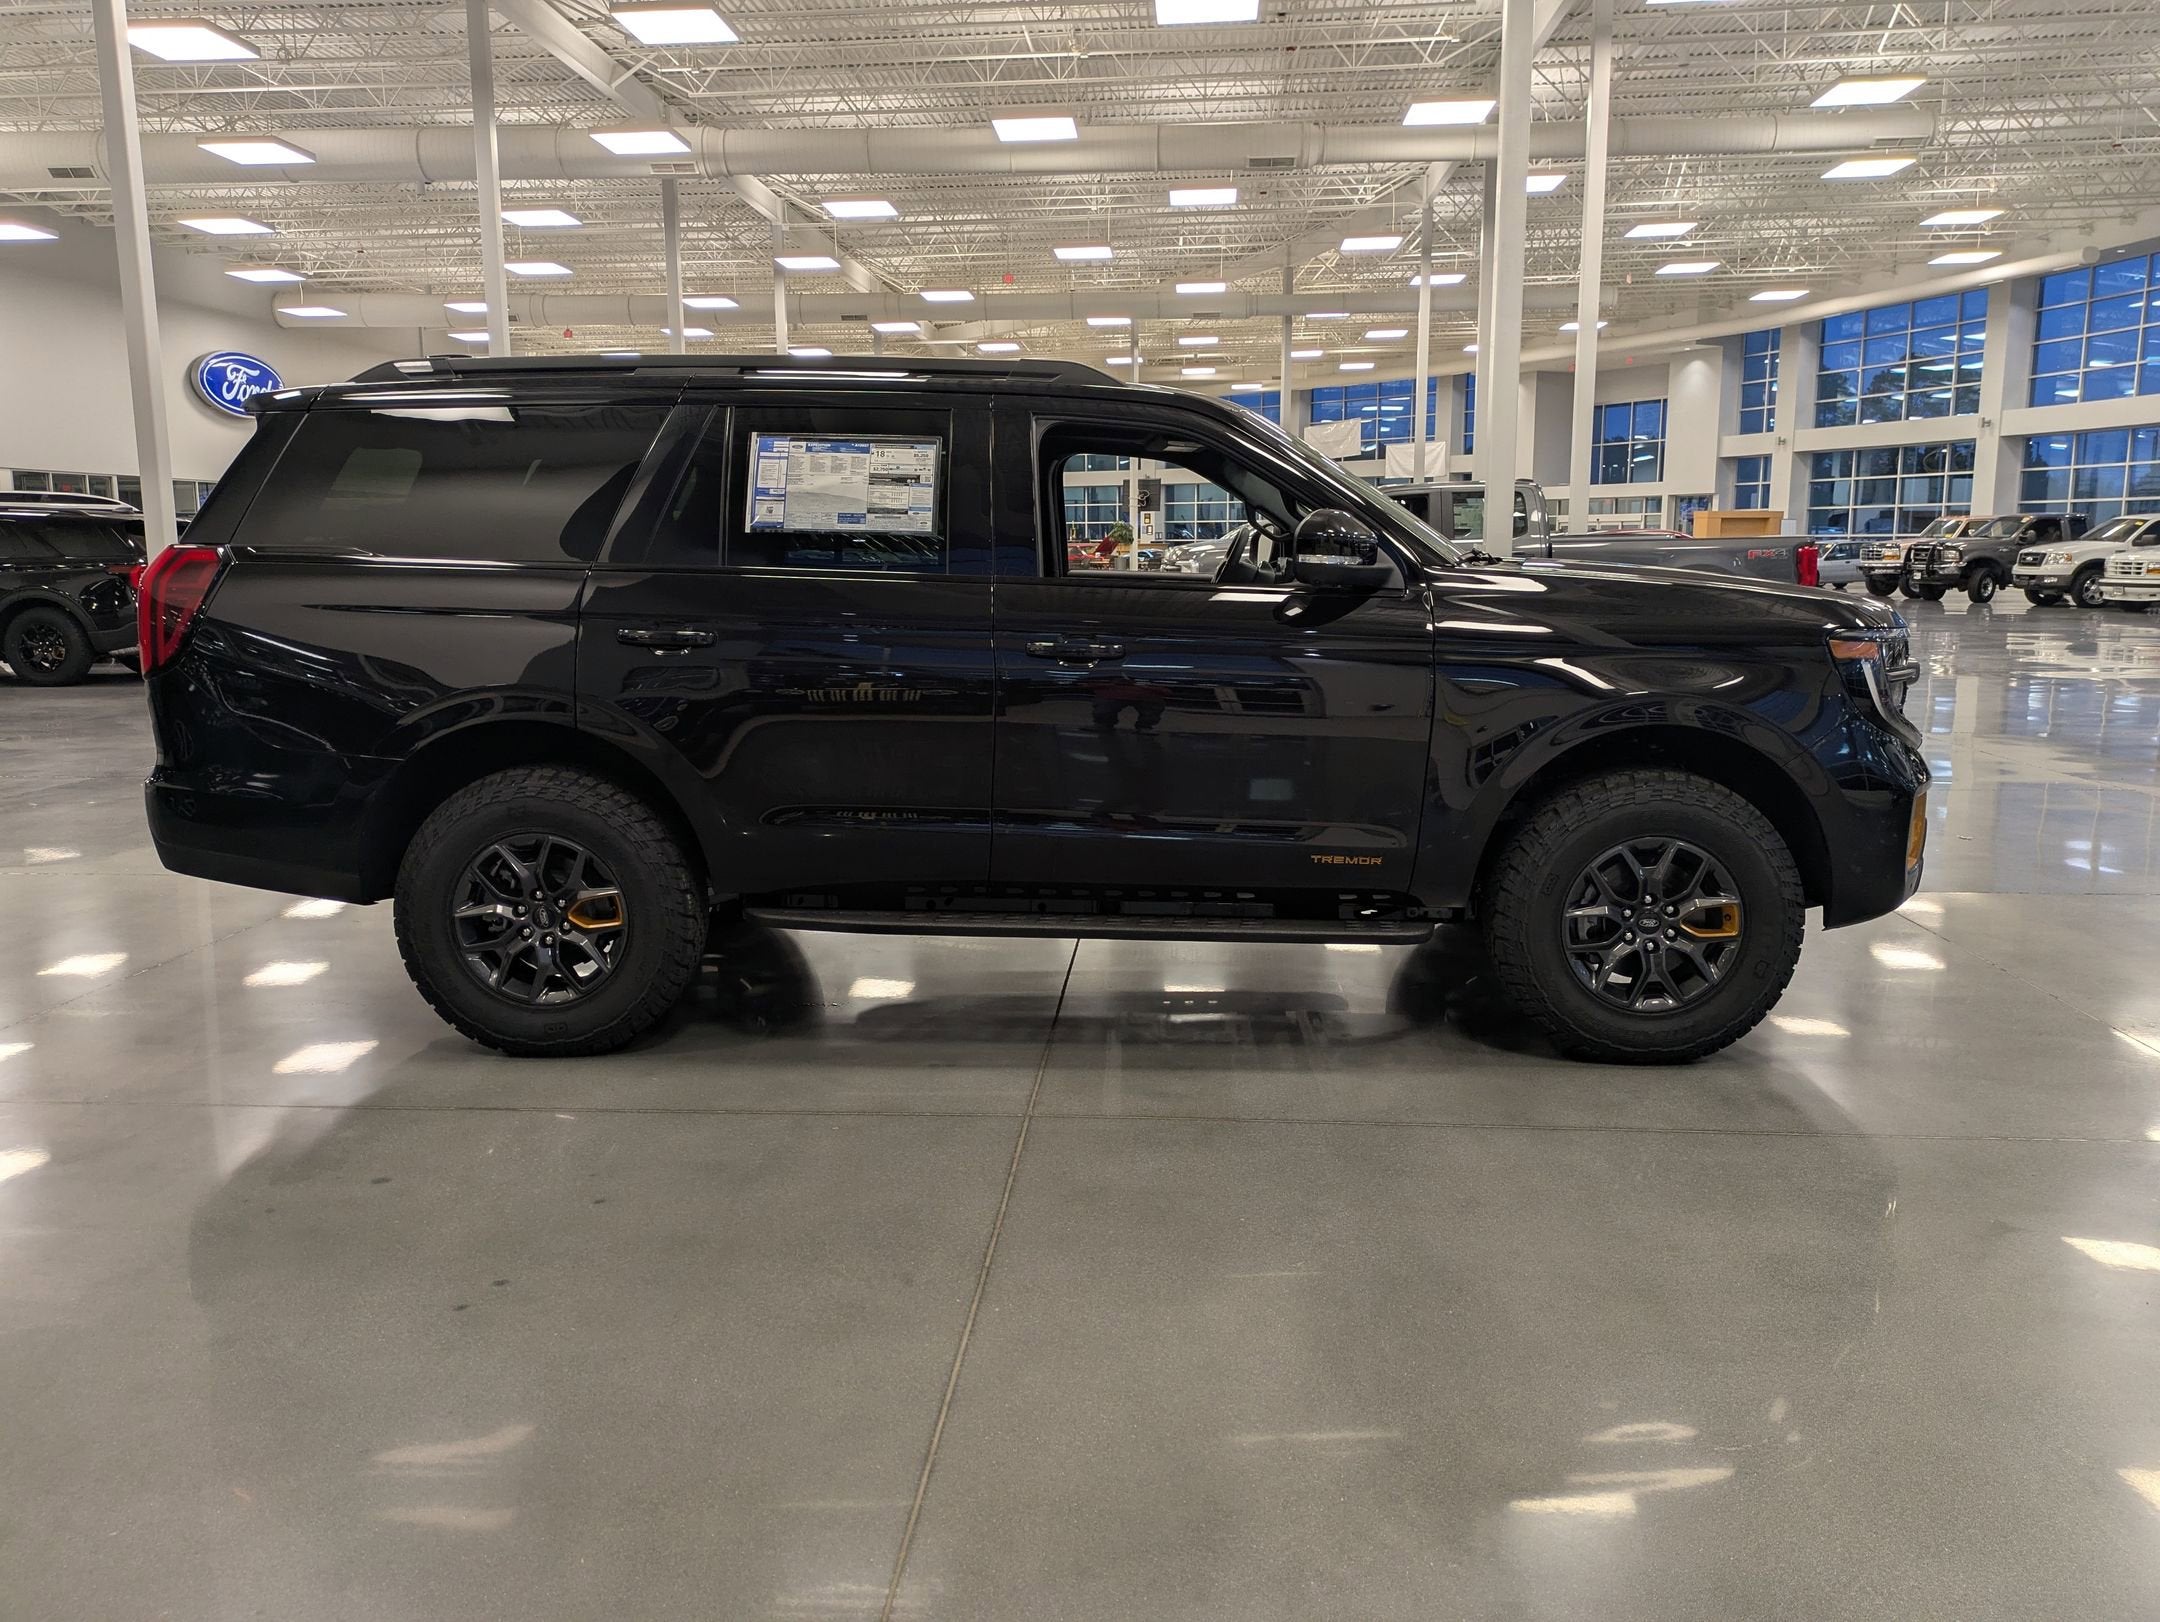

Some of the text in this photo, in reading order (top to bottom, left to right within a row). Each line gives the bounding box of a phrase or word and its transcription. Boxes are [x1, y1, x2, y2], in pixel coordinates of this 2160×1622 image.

[876, 450, 885, 458] 18
[1748, 548, 1788, 560] FX4
[1310, 855, 1383, 865] TREMOR
